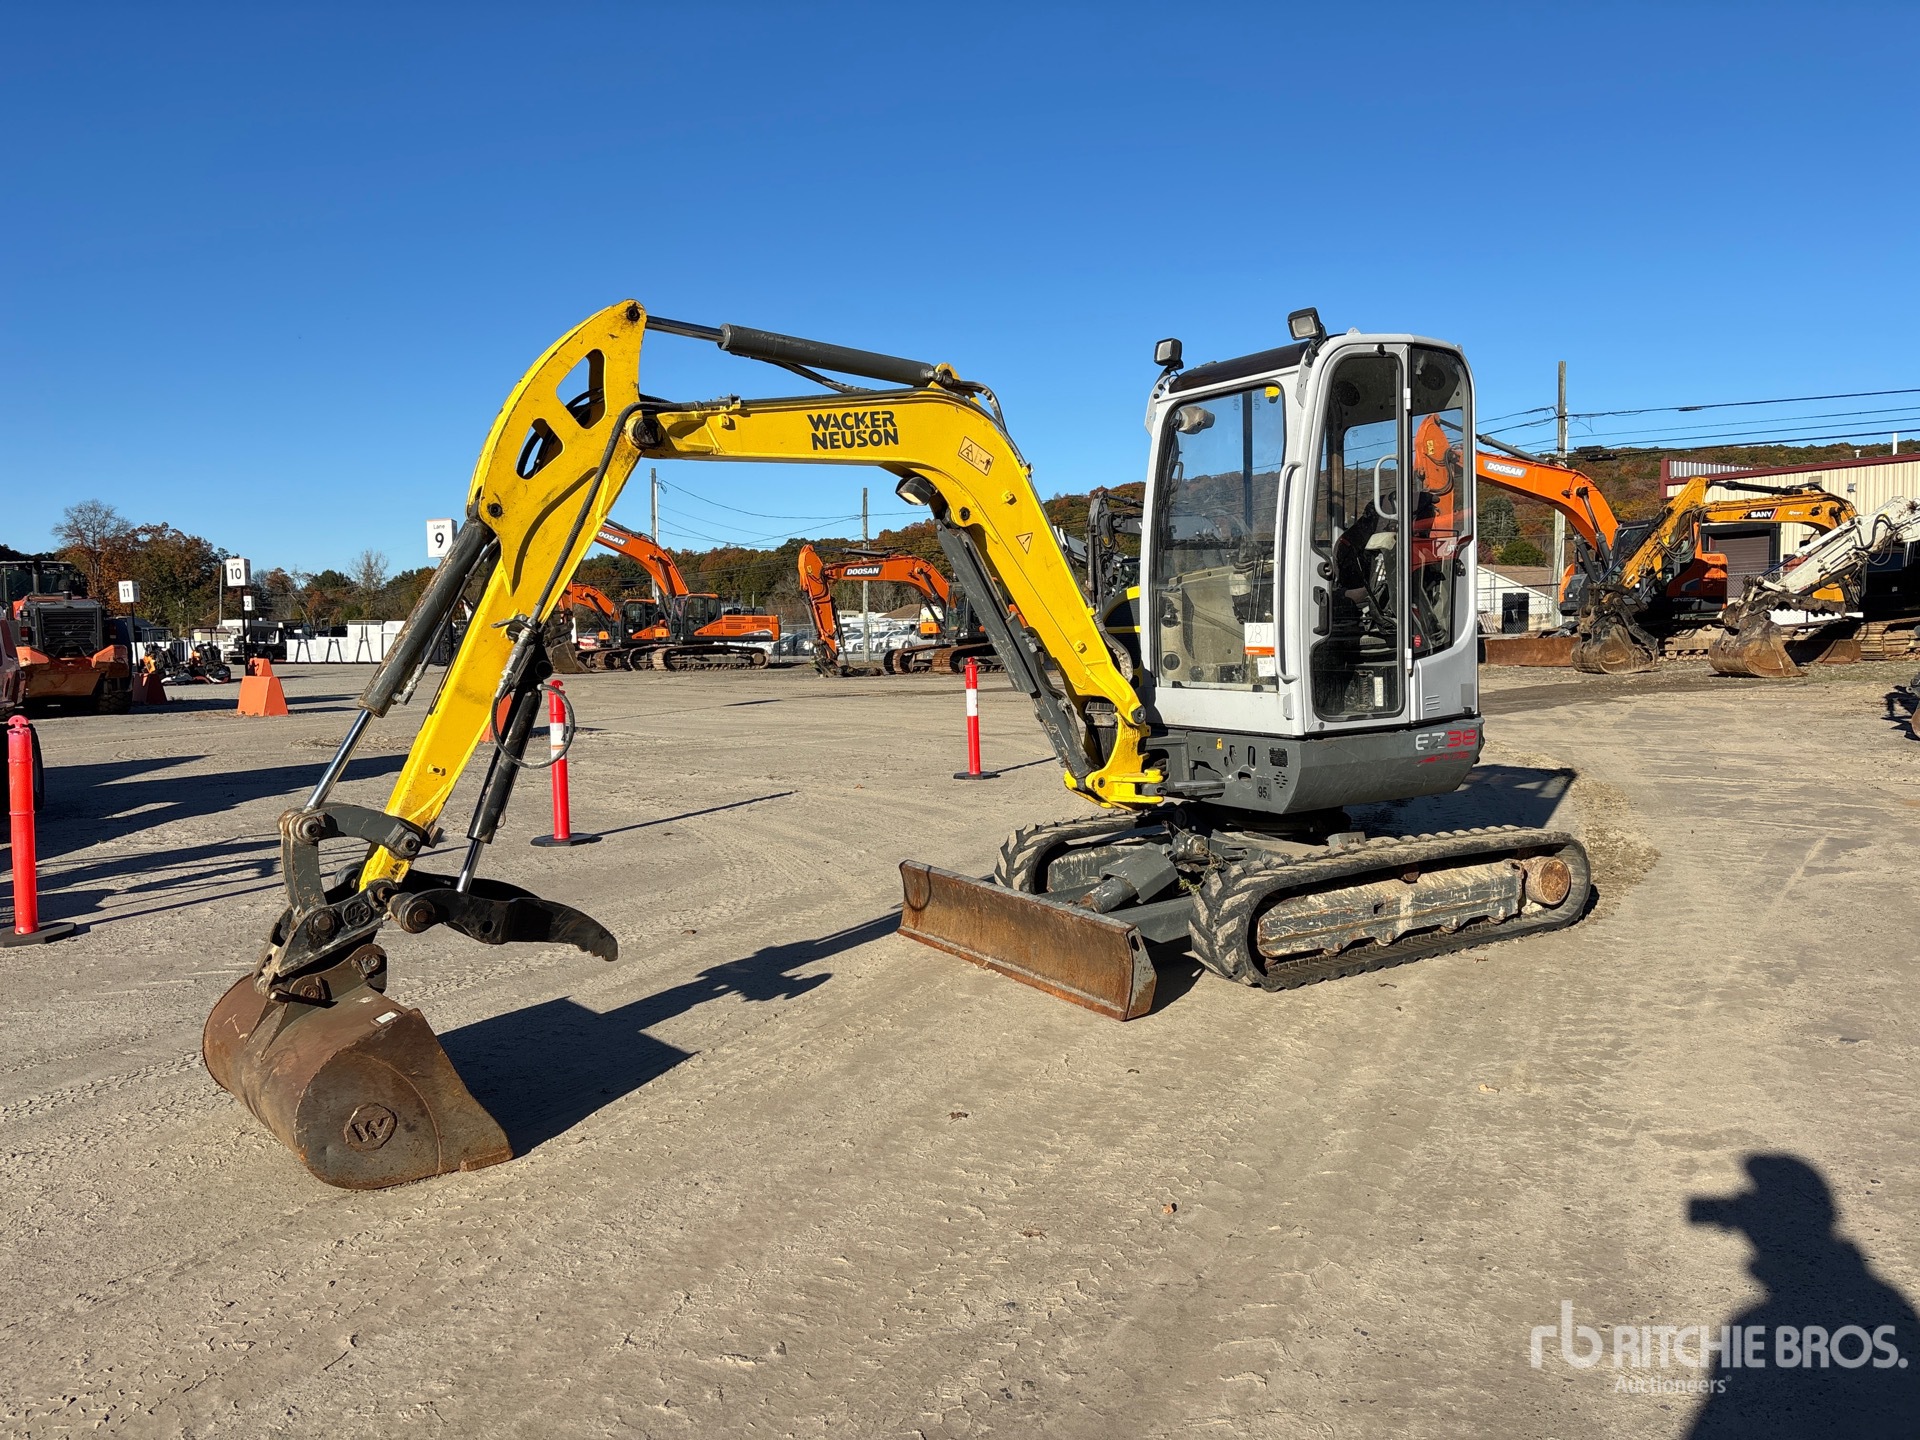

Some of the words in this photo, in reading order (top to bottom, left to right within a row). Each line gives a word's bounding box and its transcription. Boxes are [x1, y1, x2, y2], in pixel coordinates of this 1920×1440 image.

[807, 411, 897, 431] WACKER
[811, 428, 899, 450] NEUSON
[1486, 462, 1524, 476] DOOSAN
[435, 532, 444, 548] 9
[598, 531, 626, 545] OOSAN
[230, 568, 241, 579] 10
[846, 567, 879, 575] DOOSAN
[122, 588, 129, 597] 11
[1248, 624, 1268, 643] 287
[1415, 729, 1477, 751] EZ38
[1258, 786, 1267, 798] 95
